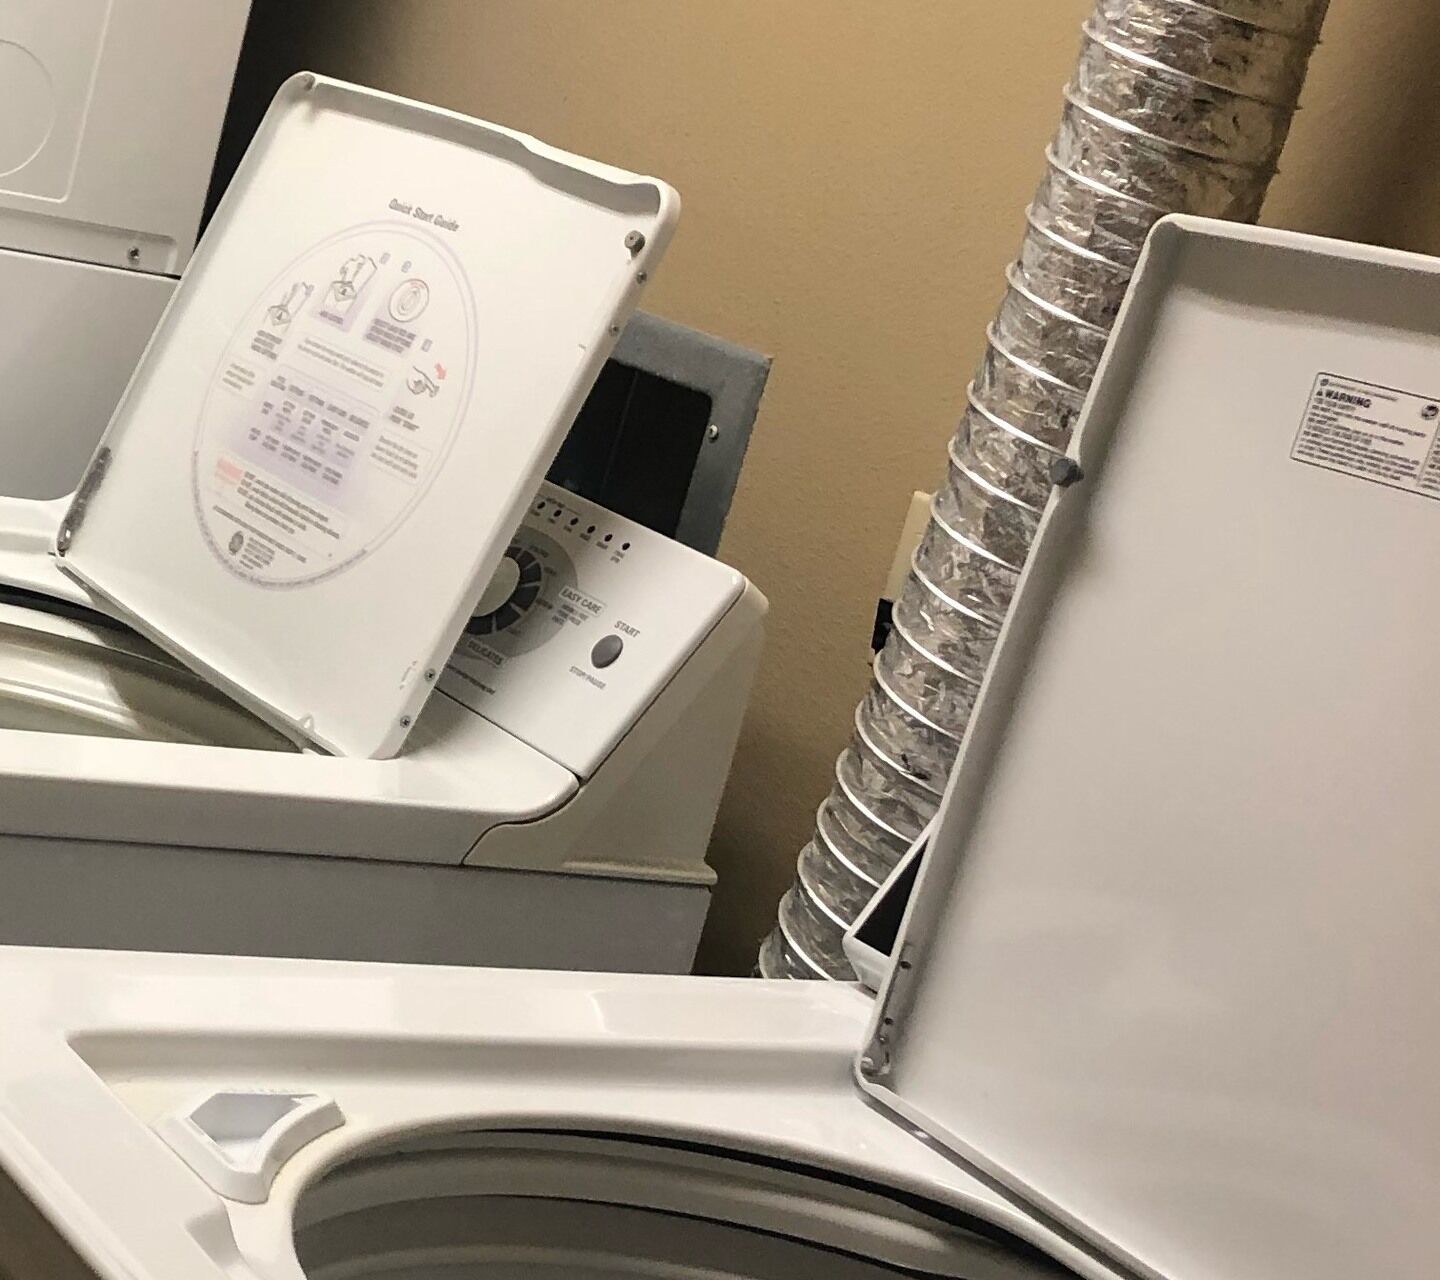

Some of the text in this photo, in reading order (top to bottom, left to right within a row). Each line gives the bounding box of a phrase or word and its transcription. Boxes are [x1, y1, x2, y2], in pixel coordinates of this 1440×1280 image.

[1324, 389, 1372, 409] WARNING
[561, 588, 582, 603] EASY
[581, 599, 603, 615] CARE
[614, 620, 641, 638] START
